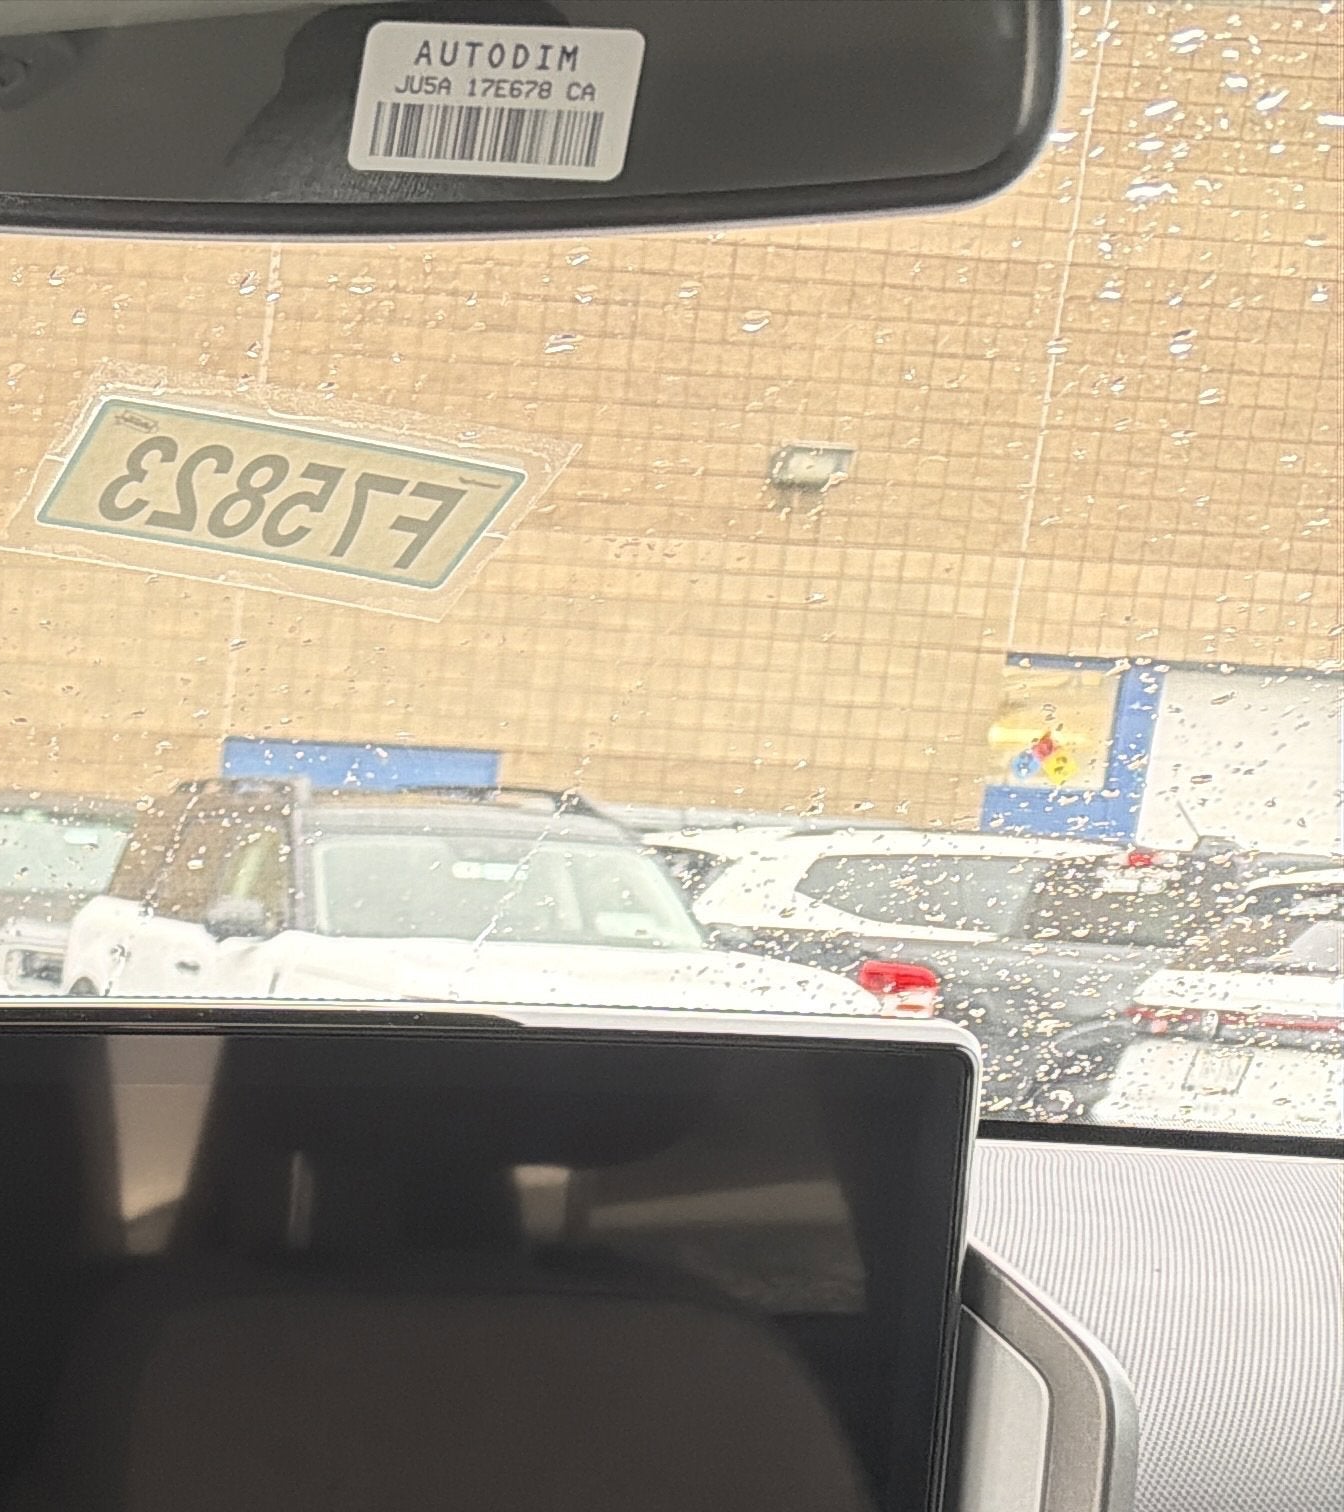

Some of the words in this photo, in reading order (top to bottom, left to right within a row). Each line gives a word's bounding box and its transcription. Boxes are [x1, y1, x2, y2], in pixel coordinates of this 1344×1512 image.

[413, 40, 580, 72] AUTODIM
[468, 79, 553, 100] 17E678
[566, 82, 597, 102] CA
